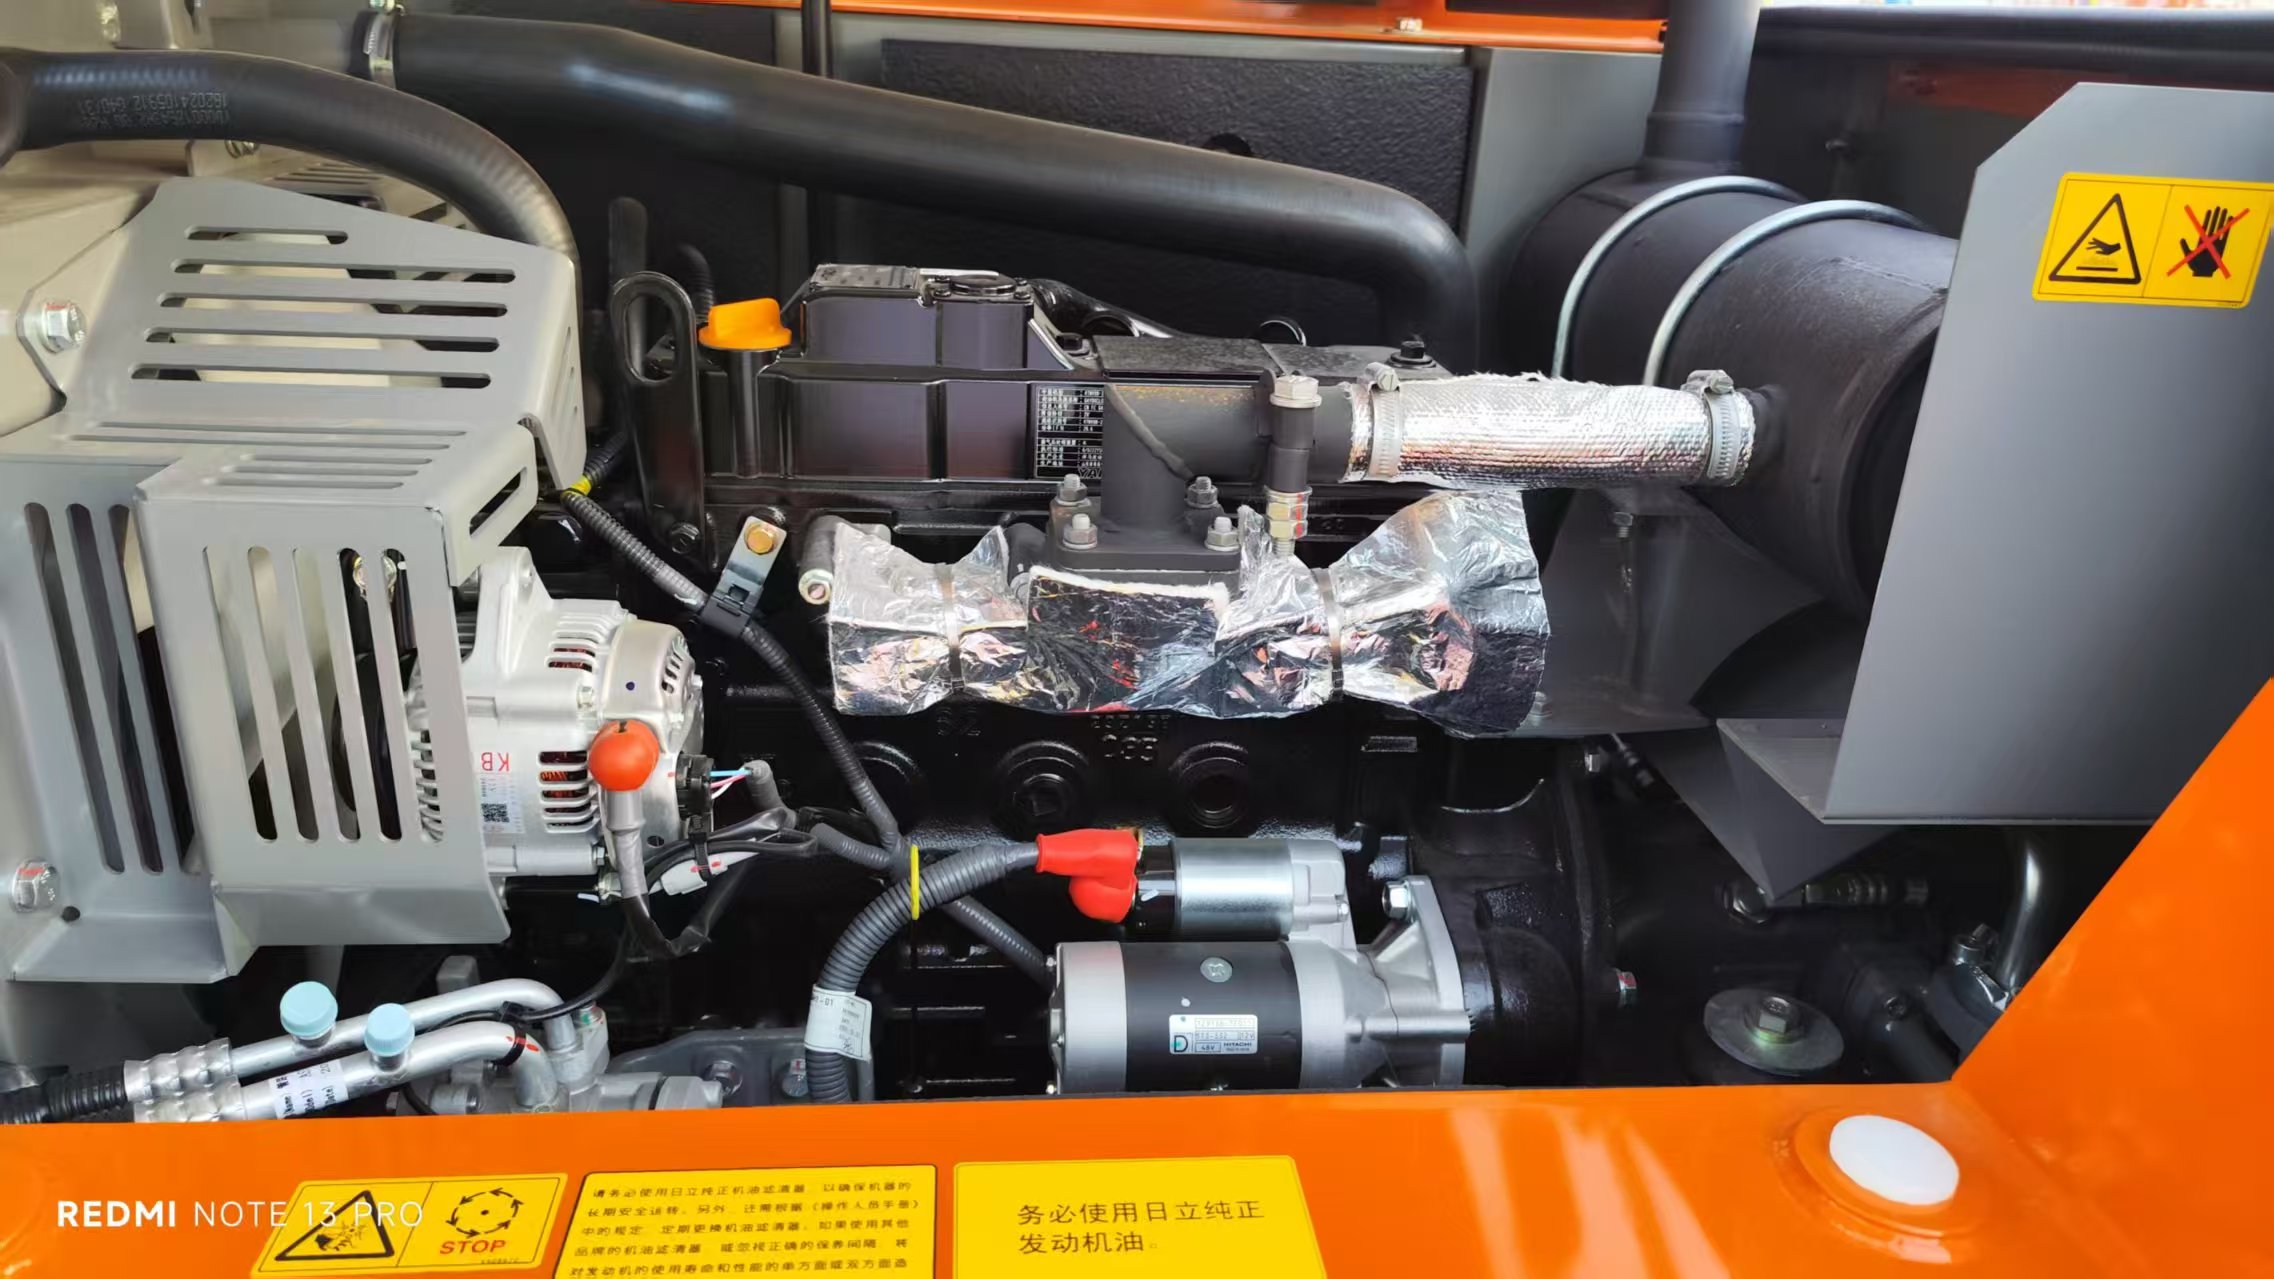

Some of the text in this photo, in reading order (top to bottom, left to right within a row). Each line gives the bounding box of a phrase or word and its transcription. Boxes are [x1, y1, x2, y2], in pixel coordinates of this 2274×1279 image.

[481, 751, 510, 772] KB
[1017, 1200, 1265, 1226] 务必使用日立纯正
[439, 1239, 506, 1255] STOP
